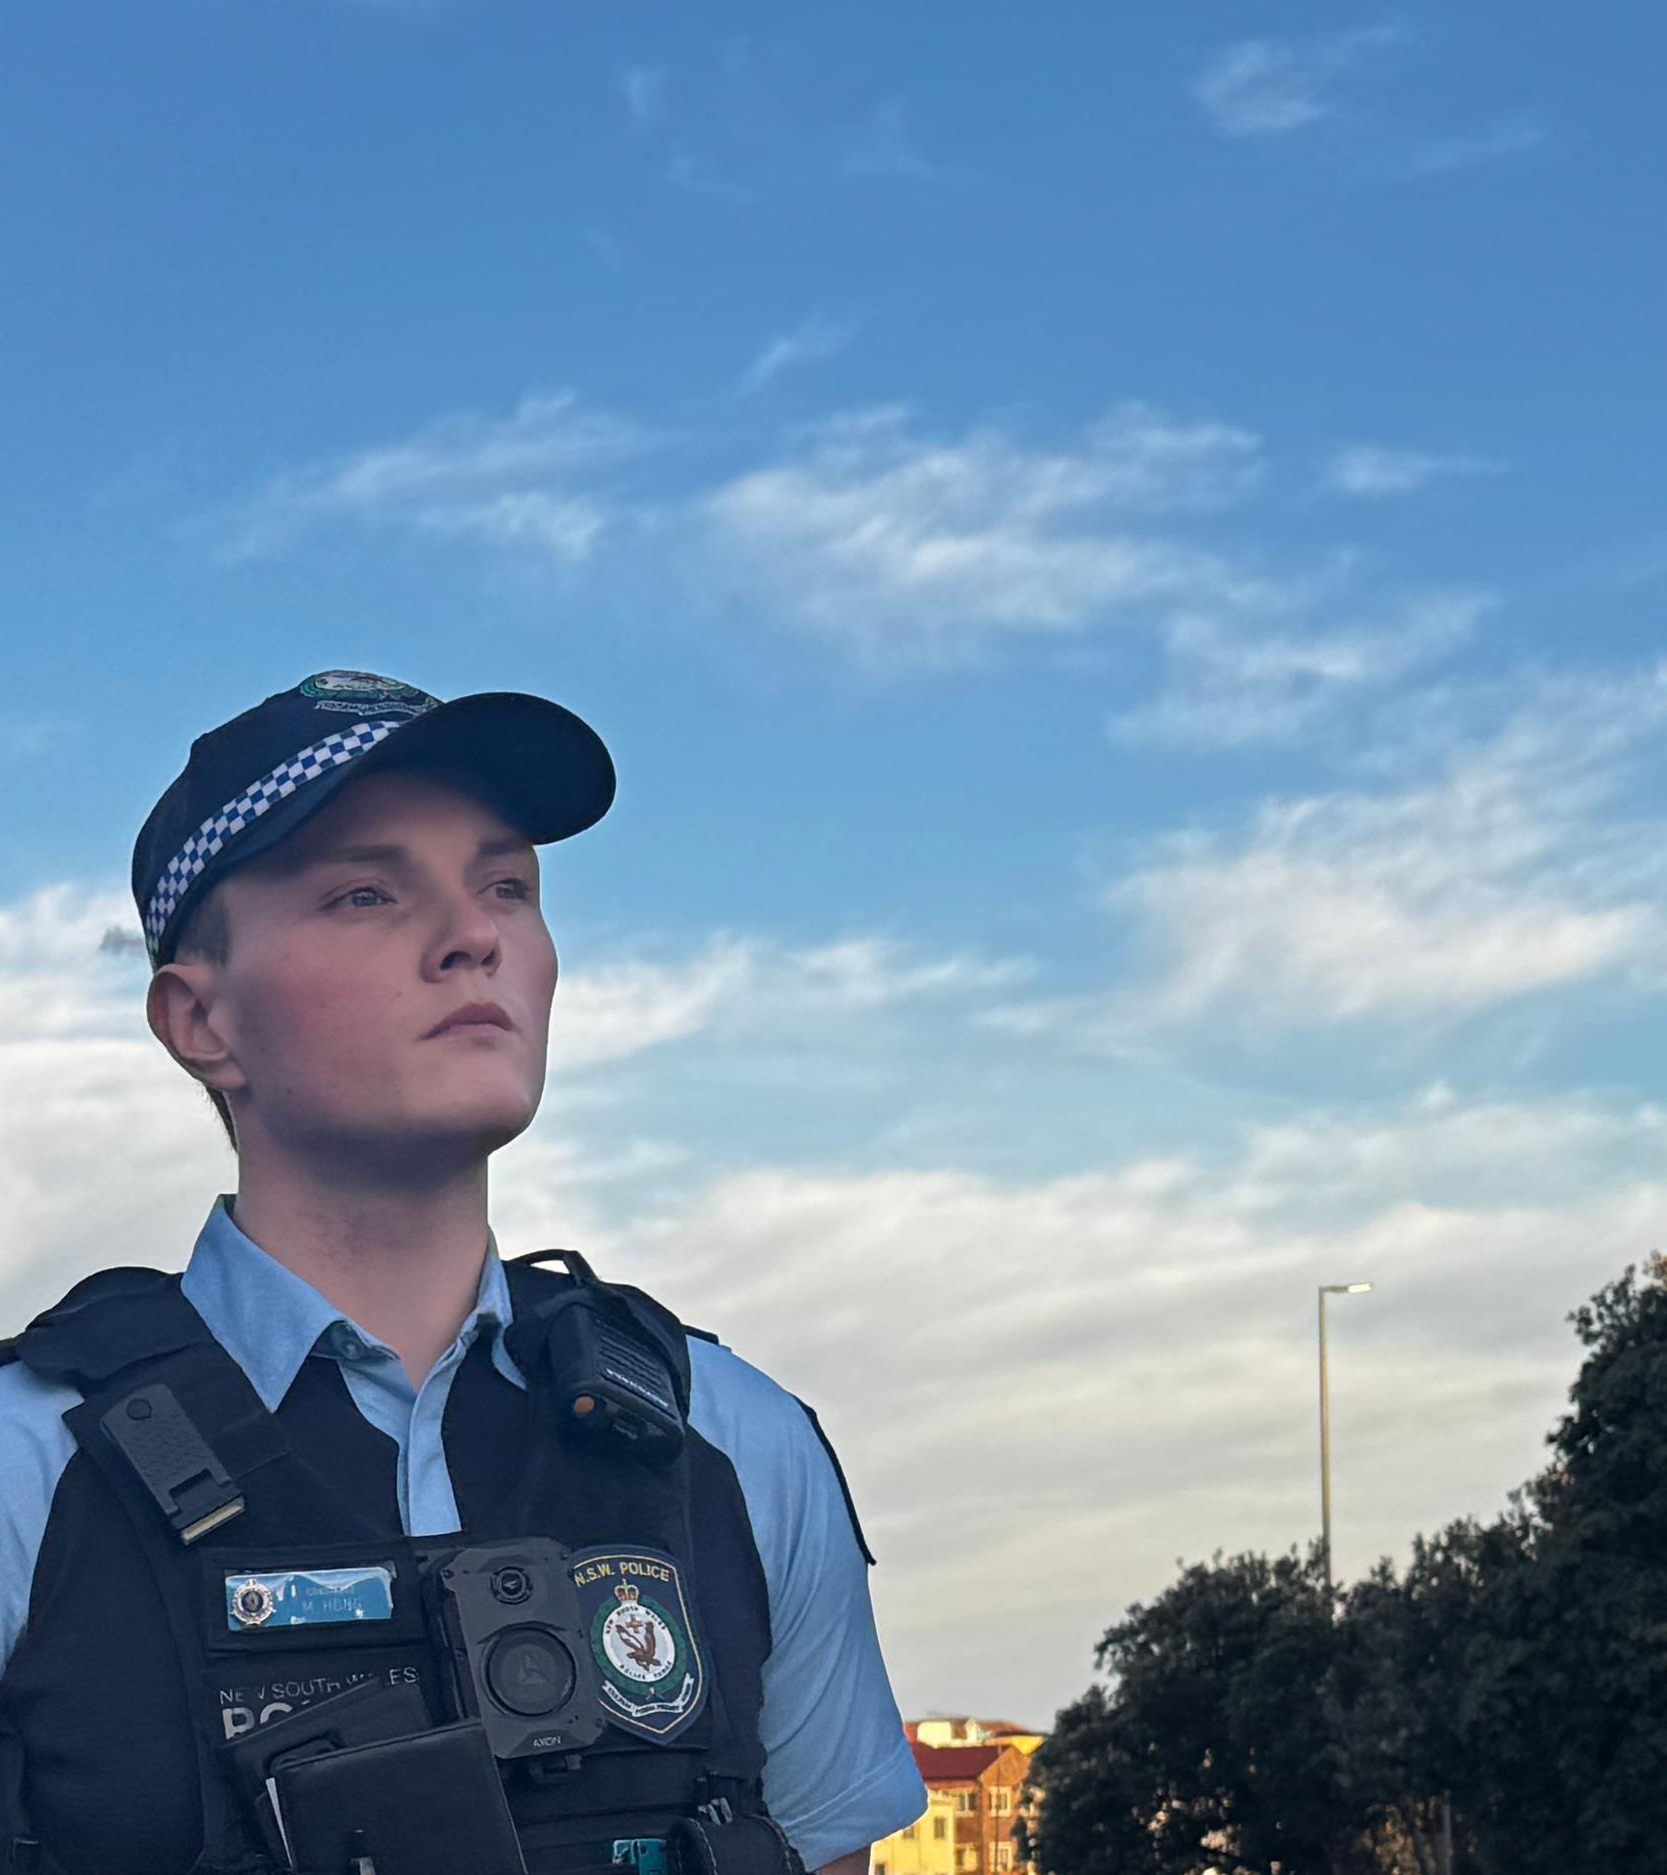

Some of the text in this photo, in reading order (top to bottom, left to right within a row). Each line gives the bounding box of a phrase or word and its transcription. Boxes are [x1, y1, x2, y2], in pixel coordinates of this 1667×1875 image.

[574, 1561, 670, 1588] N.S.W. POLICE
[533, 1736, 562, 1748] AXON
